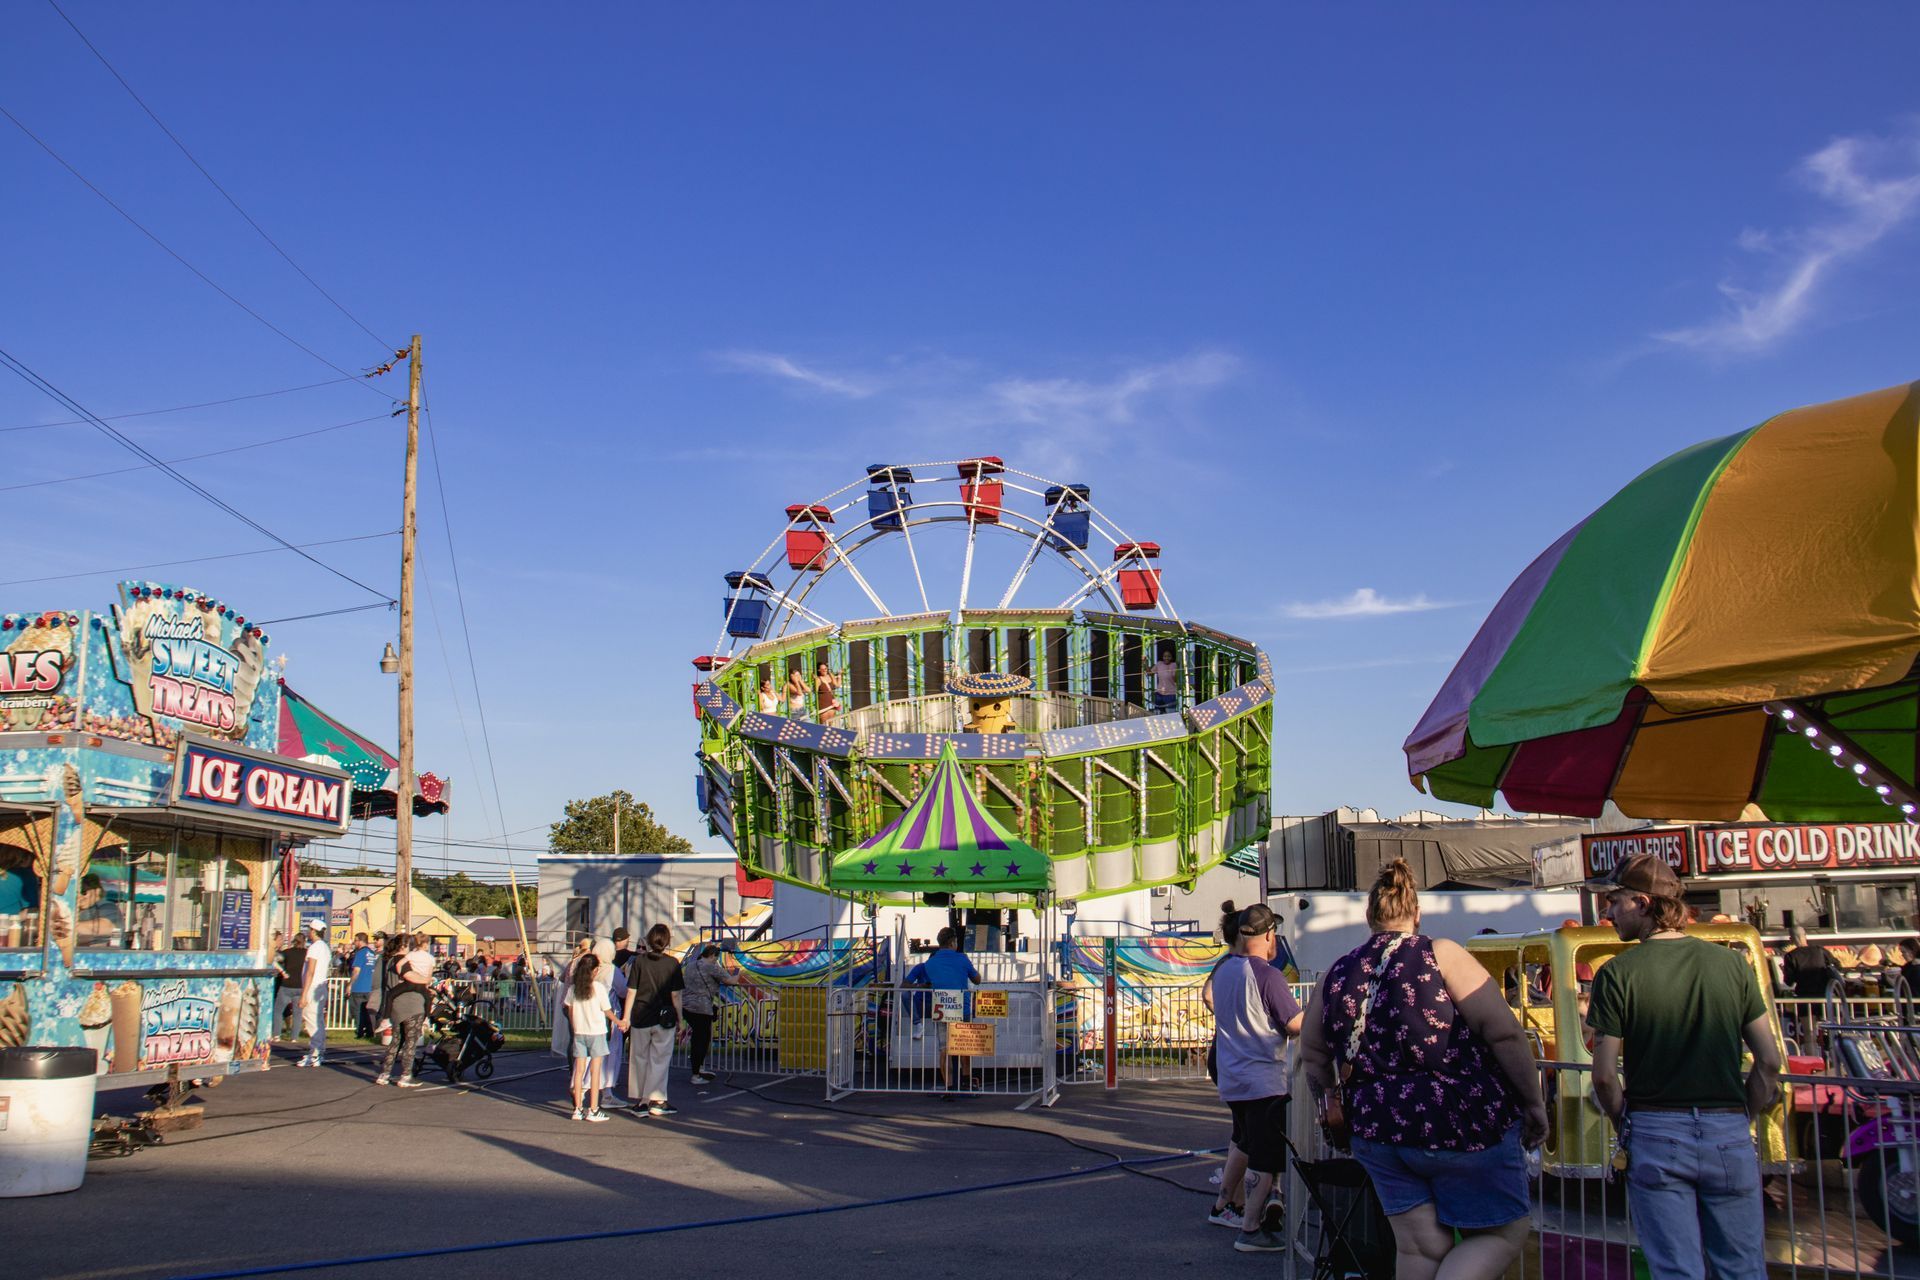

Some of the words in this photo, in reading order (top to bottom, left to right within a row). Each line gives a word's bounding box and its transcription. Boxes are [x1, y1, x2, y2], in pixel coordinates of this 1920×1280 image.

[145, 614, 202, 639] Michael's
[152, 639, 239, 695] SWEET
[149, 675, 235, 730] TREATS
[188, 753, 241, 801] ICE
[247, 767, 340, 819] CREAM
[1705, 831, 1750, 866] ICE
[1756, 828, 1829, 863] COLD
[1836, 824, 1920, 860] DRINK
[147, 998, 214, 1035] SWEET
[933, 1004, 944, 1021] 5
[1107, 996, 1114, 1015] NO
[146, 1031, 211, 1064] TREATS
